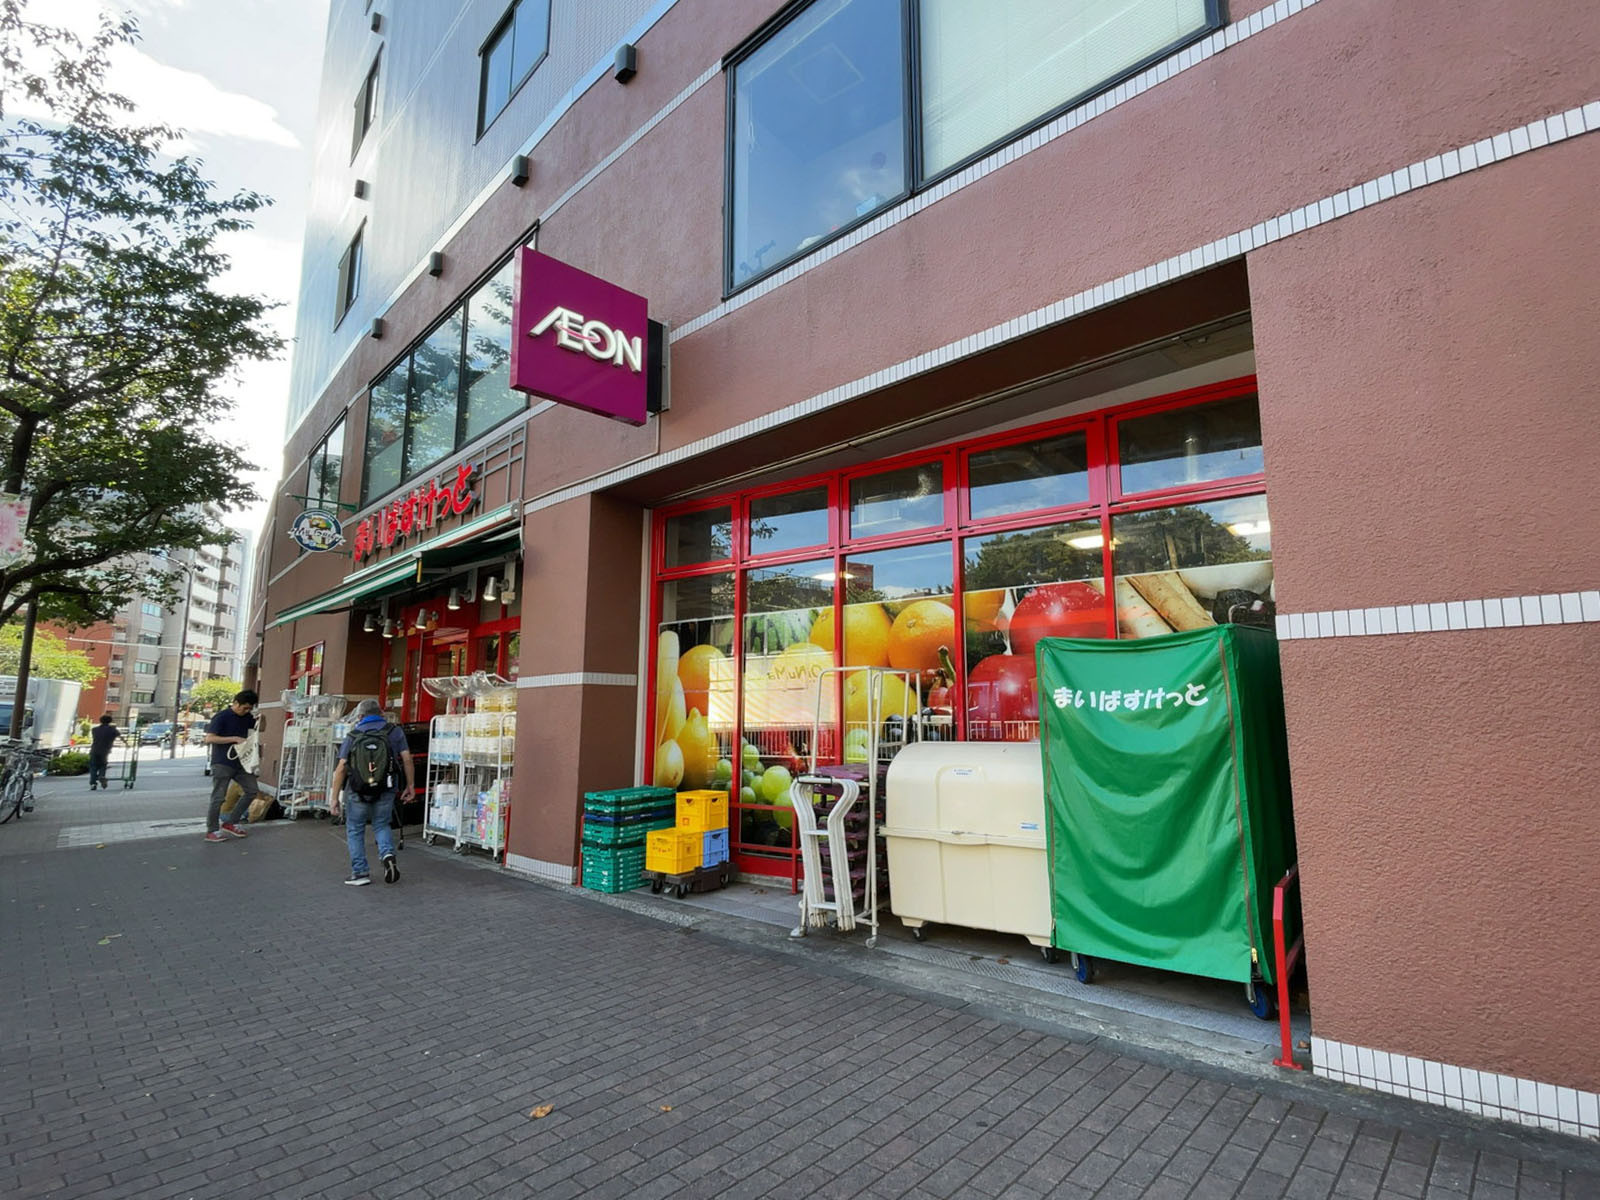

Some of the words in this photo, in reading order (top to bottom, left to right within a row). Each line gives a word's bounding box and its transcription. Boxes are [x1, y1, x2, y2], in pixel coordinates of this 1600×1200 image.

[528, 305, 642, 373] AEON
[353, 462, 477, 562] まいばすけっと
[1053, 683, 1208, 712] まいばすけっと
